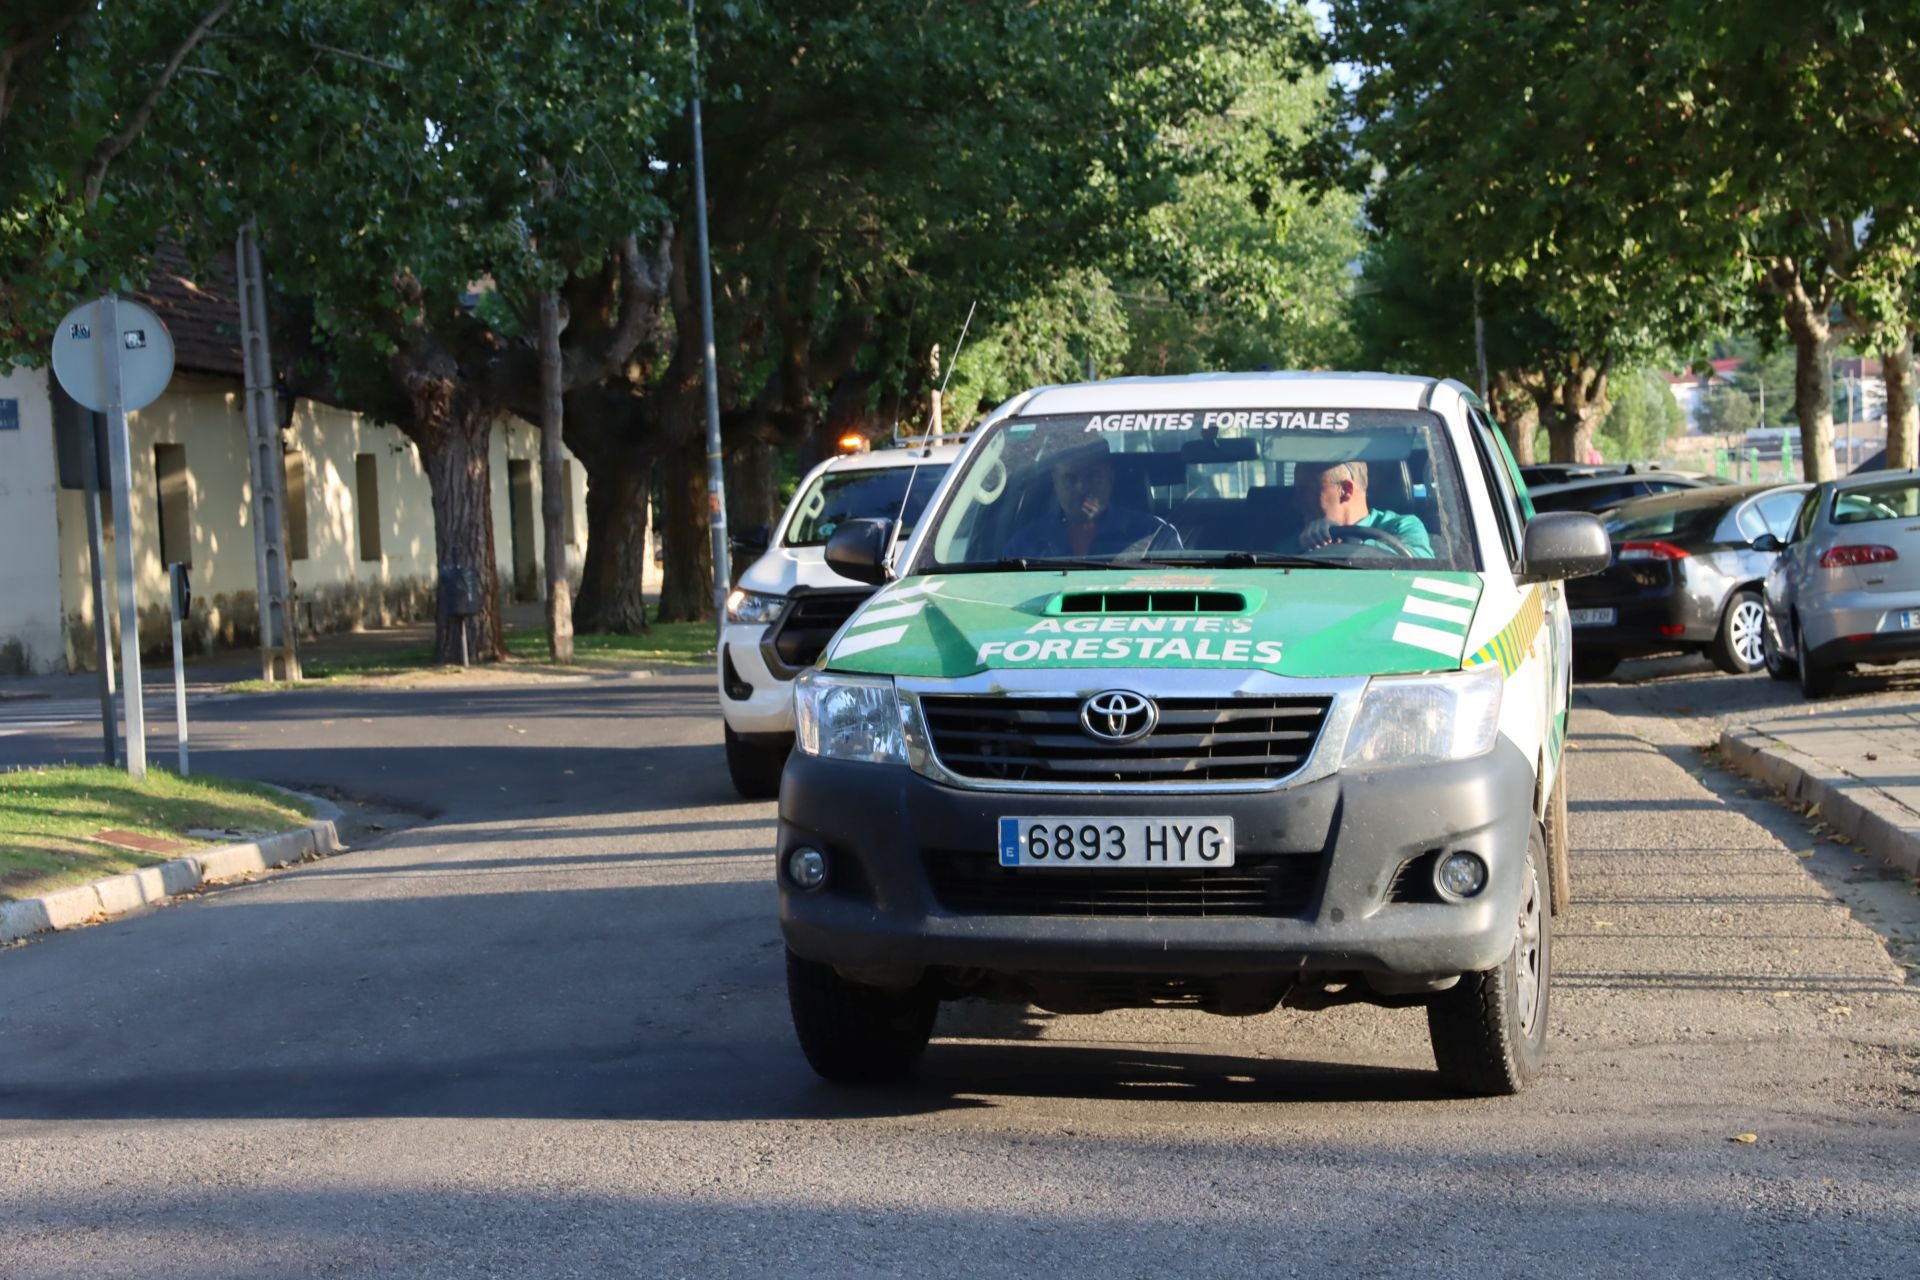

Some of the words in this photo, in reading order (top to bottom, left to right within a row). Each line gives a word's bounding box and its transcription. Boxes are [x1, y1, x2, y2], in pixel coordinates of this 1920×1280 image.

[1084, 413, 1195, 432] AGENTES
[1202, 411, 1350, 430] FORESTALES
[1024, 616, 1254, 634] AGENTES
[975, 637, 1284, 666] FORESTALES
[1005, 846, 1015, 857] E
[1028, 824, 1127, 861] 6893
[1145, 825, 1222, 862] HYG
